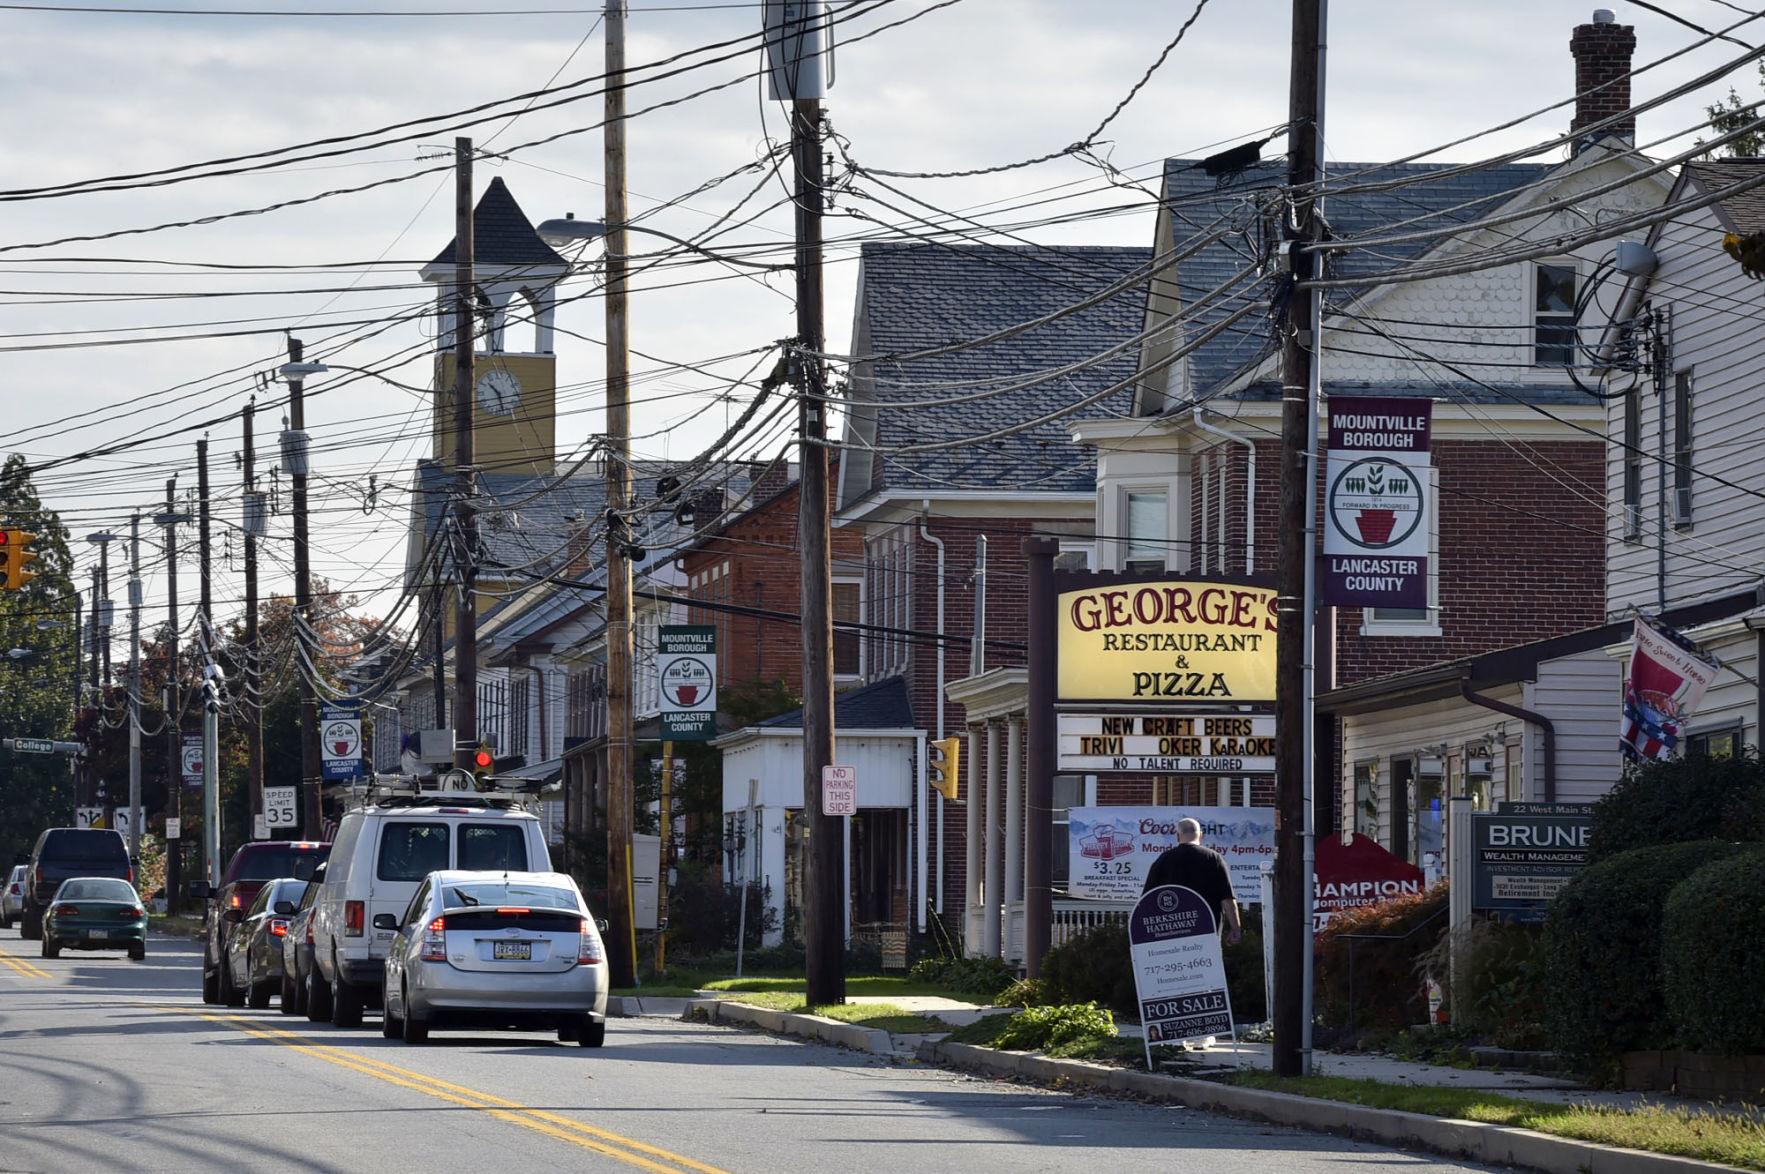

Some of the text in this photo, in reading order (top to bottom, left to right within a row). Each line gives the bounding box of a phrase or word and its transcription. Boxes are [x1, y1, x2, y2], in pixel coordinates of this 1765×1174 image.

[1333, 414, 1425, 431] MOUNTVILLE
[1343, 432, 1414, 448] BOROUGH
[1332, 559, 1418, 575] LANCASTER
[1345, 576, 1405, 591] COUNTY
[661, 634, 713, 643] MOUNTVILLE
[1102, 633, 1262, 652] RESTAURANT
[667, 644, 707, 652] BOROUGH
[1175, 654, 1190, 669] &
[1132, 672, 1232, 697] PIZZA
[663, 713, 711, 723] LANCASTER
[671, 722, 704, 732] COUNTY
[1102, 717, 1252, 736] NEW CRAFT BEERS
[16, 740, 52, 751] College
[1112, 757, 1243, 770] NO TALENT REQUIRED
[832, 769, 846, 778] NO
[452, 779, 468, 790] NO
[826, 780, 854, 790] PARKING
[266, 791, 294, 799] SPEED
[829, 791, 851, 801] THIS
[269, 799, 290, 807] LIMIT
[829, 802, 851, 812] SIDE
[1513, 805, 1526, 813] 22
[1529, 805, 1552, 813] West
[1555, 805, 1578, 814] Main
[268, 807, 294, 823] 35
[1139, 817, 1225, 835] Coor GHT
[1489, 825, 1591, 847] BRUNE
[1142, 843, 1173, 853] Mond
[1231, 844, 1273, 856] 4pm-6p
[1484, 851, 1584, 861] WEALTH MANAGEME
[1313, 880, 1418, 897] HAMPION
[1314, 897, 1376, 909] omputer
[1143, 910, 1199, 926] BERKSHIRE
[1146, 919, 1197, 934] HATHAWAY
[1144, 957, 1213, 976] 717-295-4663
[1146, 994, 1225, 1019] FOR SALE
[1163, 1013, 1228, 1032] SUZANNE BOYD
